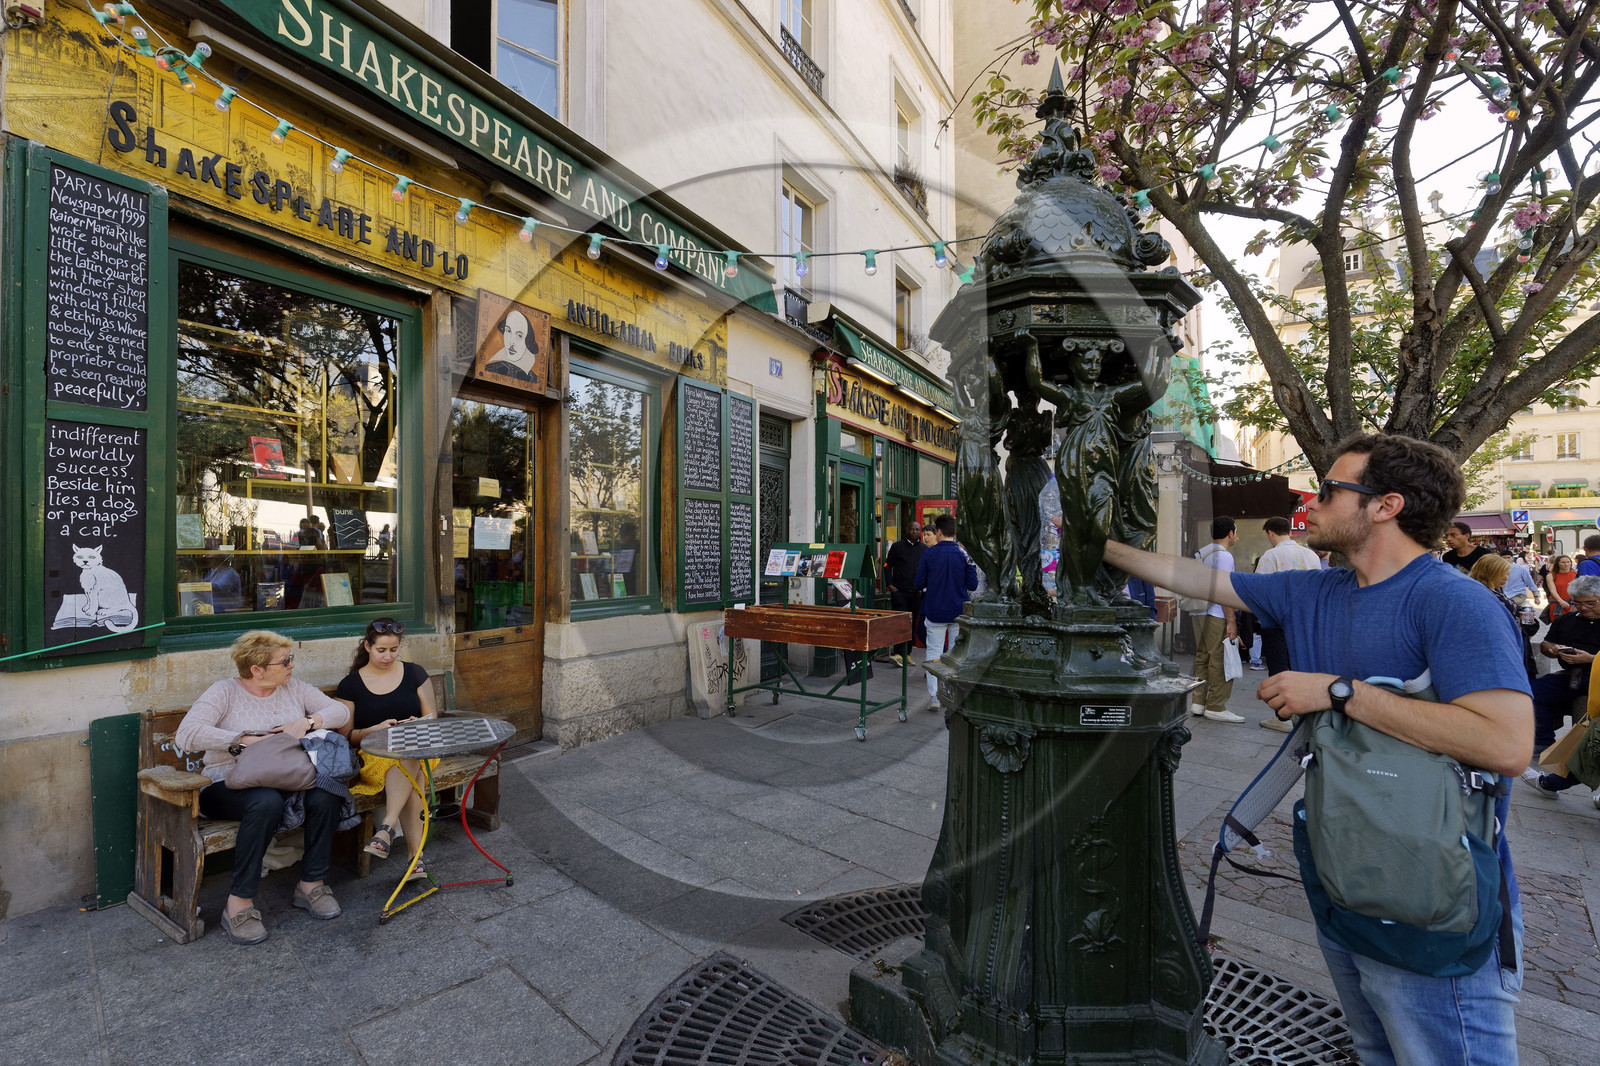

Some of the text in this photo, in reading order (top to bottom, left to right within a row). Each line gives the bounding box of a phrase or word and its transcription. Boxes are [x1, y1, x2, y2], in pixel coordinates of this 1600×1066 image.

[278, 0, 729, 289] SHAKESPEARE AND COMPANY
[54, 168, 146, 215] PARIS WALL
[51, 186, 146, 228] Newspaper 1999
[50, 207, 146, 248] Rainer Maria Rilke
[50, 223, 147, 262] wrote about the
[385, 226, 435, 268] AND
[50, 249, 73, 265] the
[105, 267, 147, 286] quarter
[92, 250, 128, 270] shops
[131, 262, 145, 278] of
[49, 279, 146, 314] windows filled
[50, 266, 146, 303] with their shop
[49, 292, 137, 322] with old books
[50, 304, 147, 339] & etchings. Where
[49, 320, 146, 351] nobody seemed
[50, 333, 144, 363] to enter & the
[50, 349, 146, 376] proprietor could
[669, 340, 704, 370] BOOKS
[771, 360, 781, 377] 37
[860, 340, 915, 391] SHAKESPEARE
[915, 376, 928, 398] AND
[50, 361, 146, 396] be seen reading
[51, 425, 140, 446] indifferent
[49, 442, 135, 468] to worldly
[46, 475, 135, 495] Beside him
[56, 462, 134, 480] success.
[47, 508, 128, 526] or perhaps
[49, 490, 138, 517] lies a dog
[60, 522, 118, 537] a cat.
[1290, 517, 1306, 530] La
[1366, 769, 1399, 778] QUECHUA
